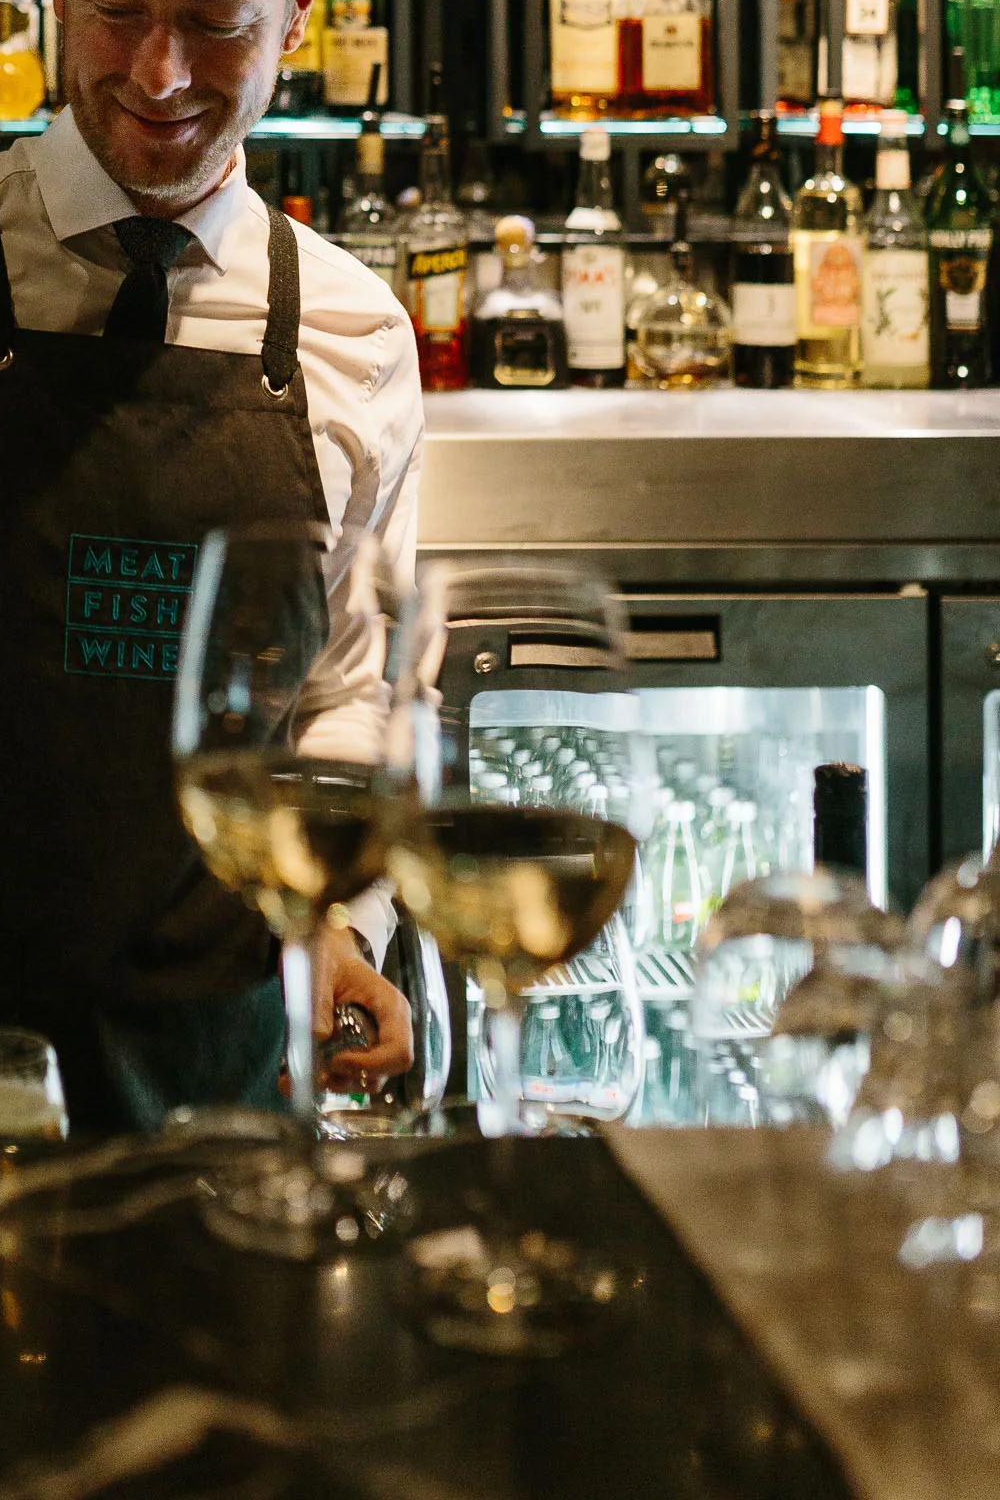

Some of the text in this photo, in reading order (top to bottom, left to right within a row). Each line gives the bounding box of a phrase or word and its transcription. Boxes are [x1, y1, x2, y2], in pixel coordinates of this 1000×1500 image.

[83, 546, 185, 580] MEAT
[84, 591, 178, 624] FISH
[81, 638, 179, 671] WINE
